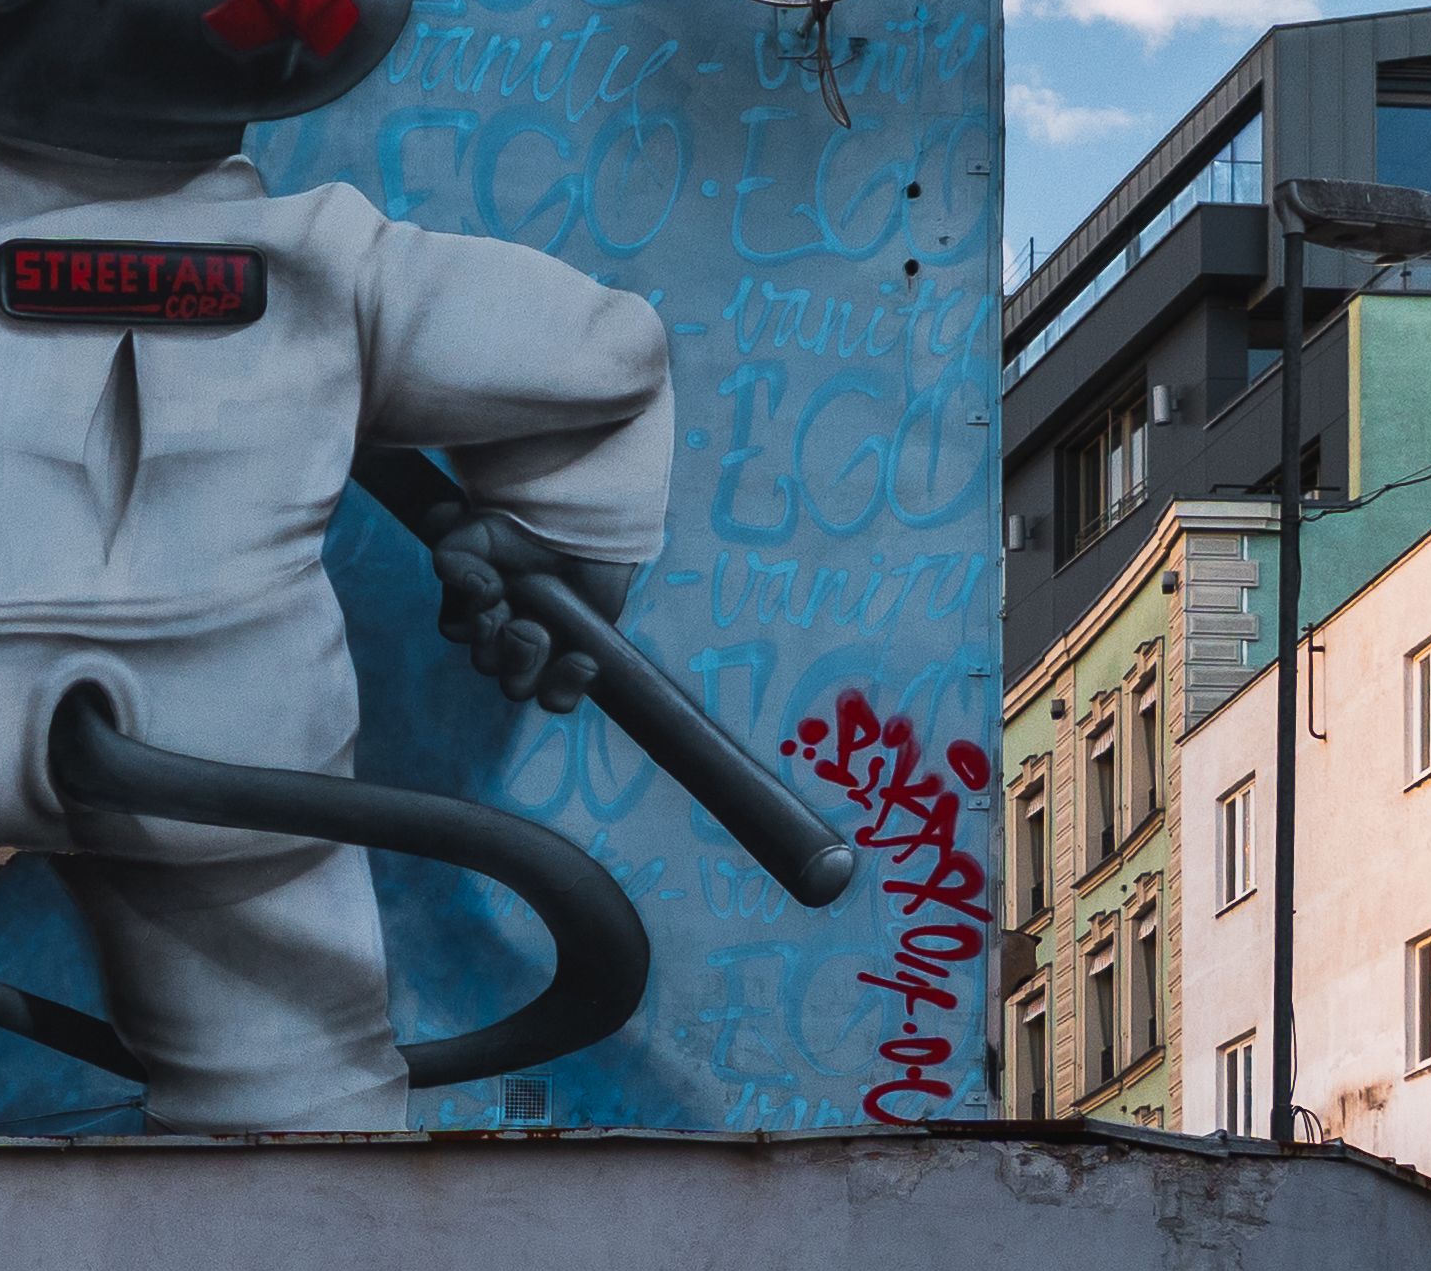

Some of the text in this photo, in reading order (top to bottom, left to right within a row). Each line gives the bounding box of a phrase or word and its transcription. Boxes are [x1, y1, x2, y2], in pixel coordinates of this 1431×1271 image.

[387, 12, 680, 124] vanity
[729, 104, 991, 268] EGO
[722, 274, 997, 363] vanity
[709, 360, 1000, 548] EGO
[710, 549, 989, 638] vanity
